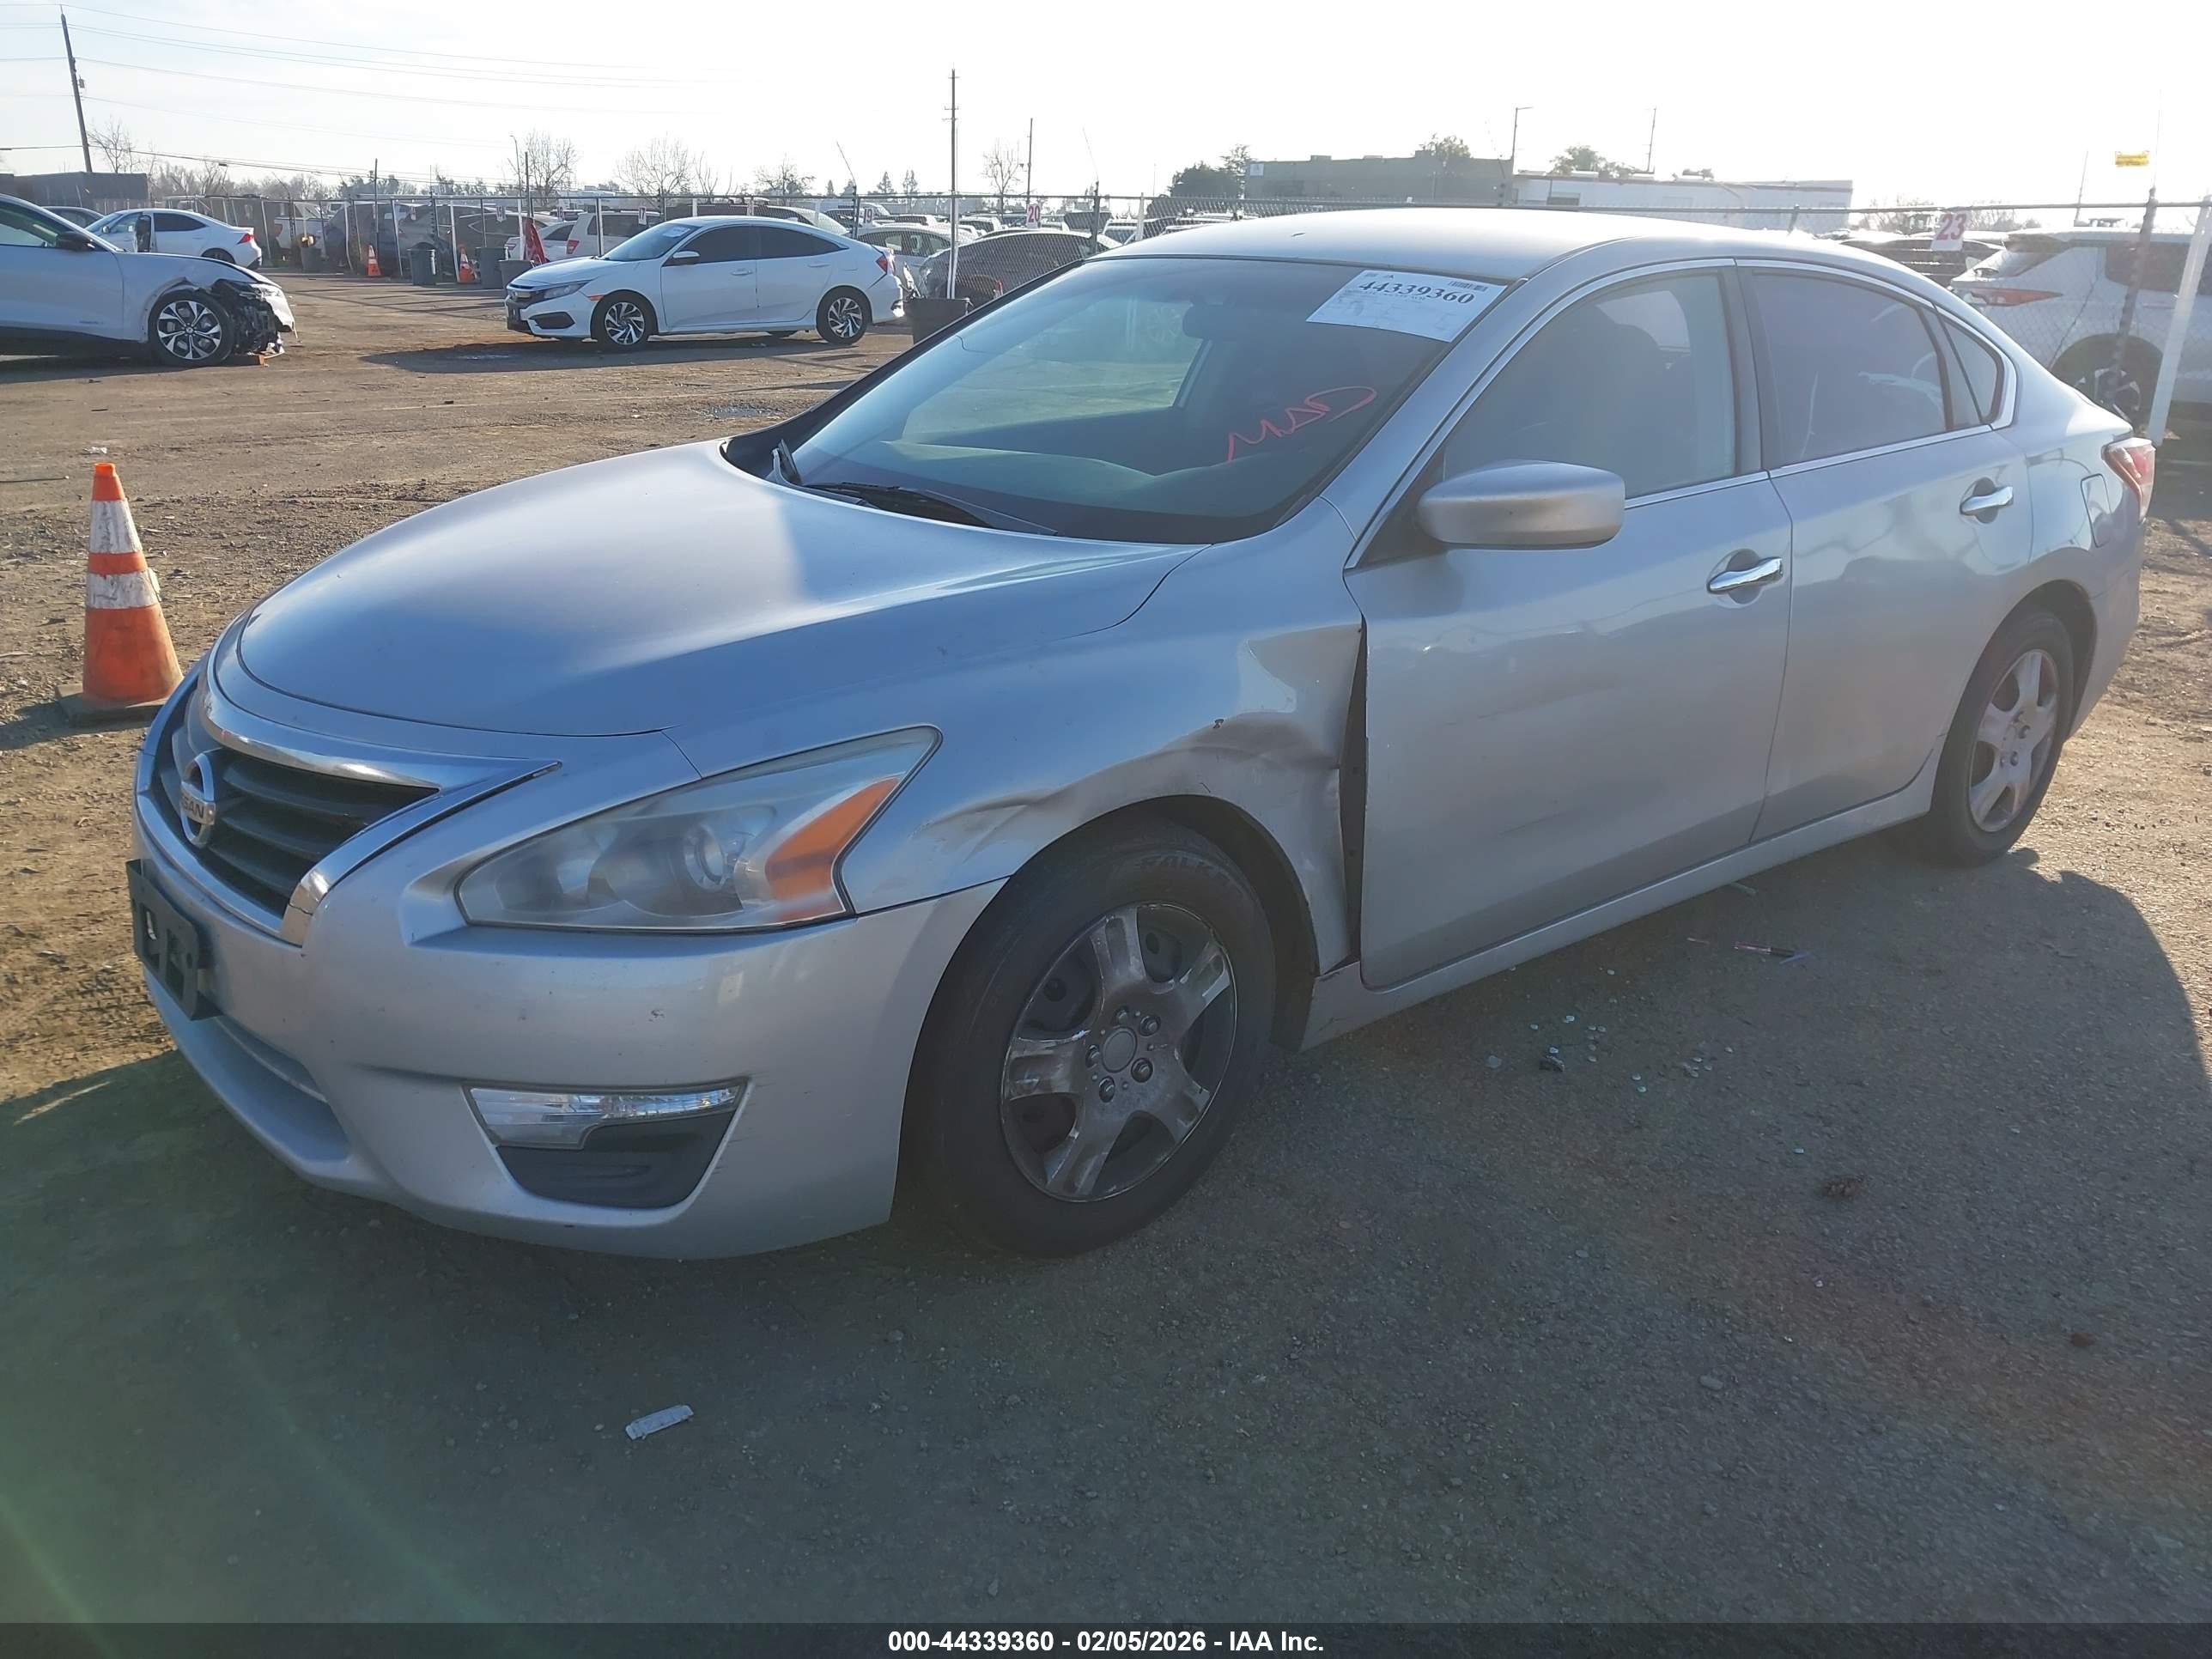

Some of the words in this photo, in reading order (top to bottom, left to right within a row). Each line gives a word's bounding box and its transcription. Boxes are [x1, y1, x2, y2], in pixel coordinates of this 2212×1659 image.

[864, 208, 873, 223] 19
[1028, 205, 1041, 222] 20
[1936, 213, 1966, 240] 23
[1358, 280, 1475, 304] 44339360
